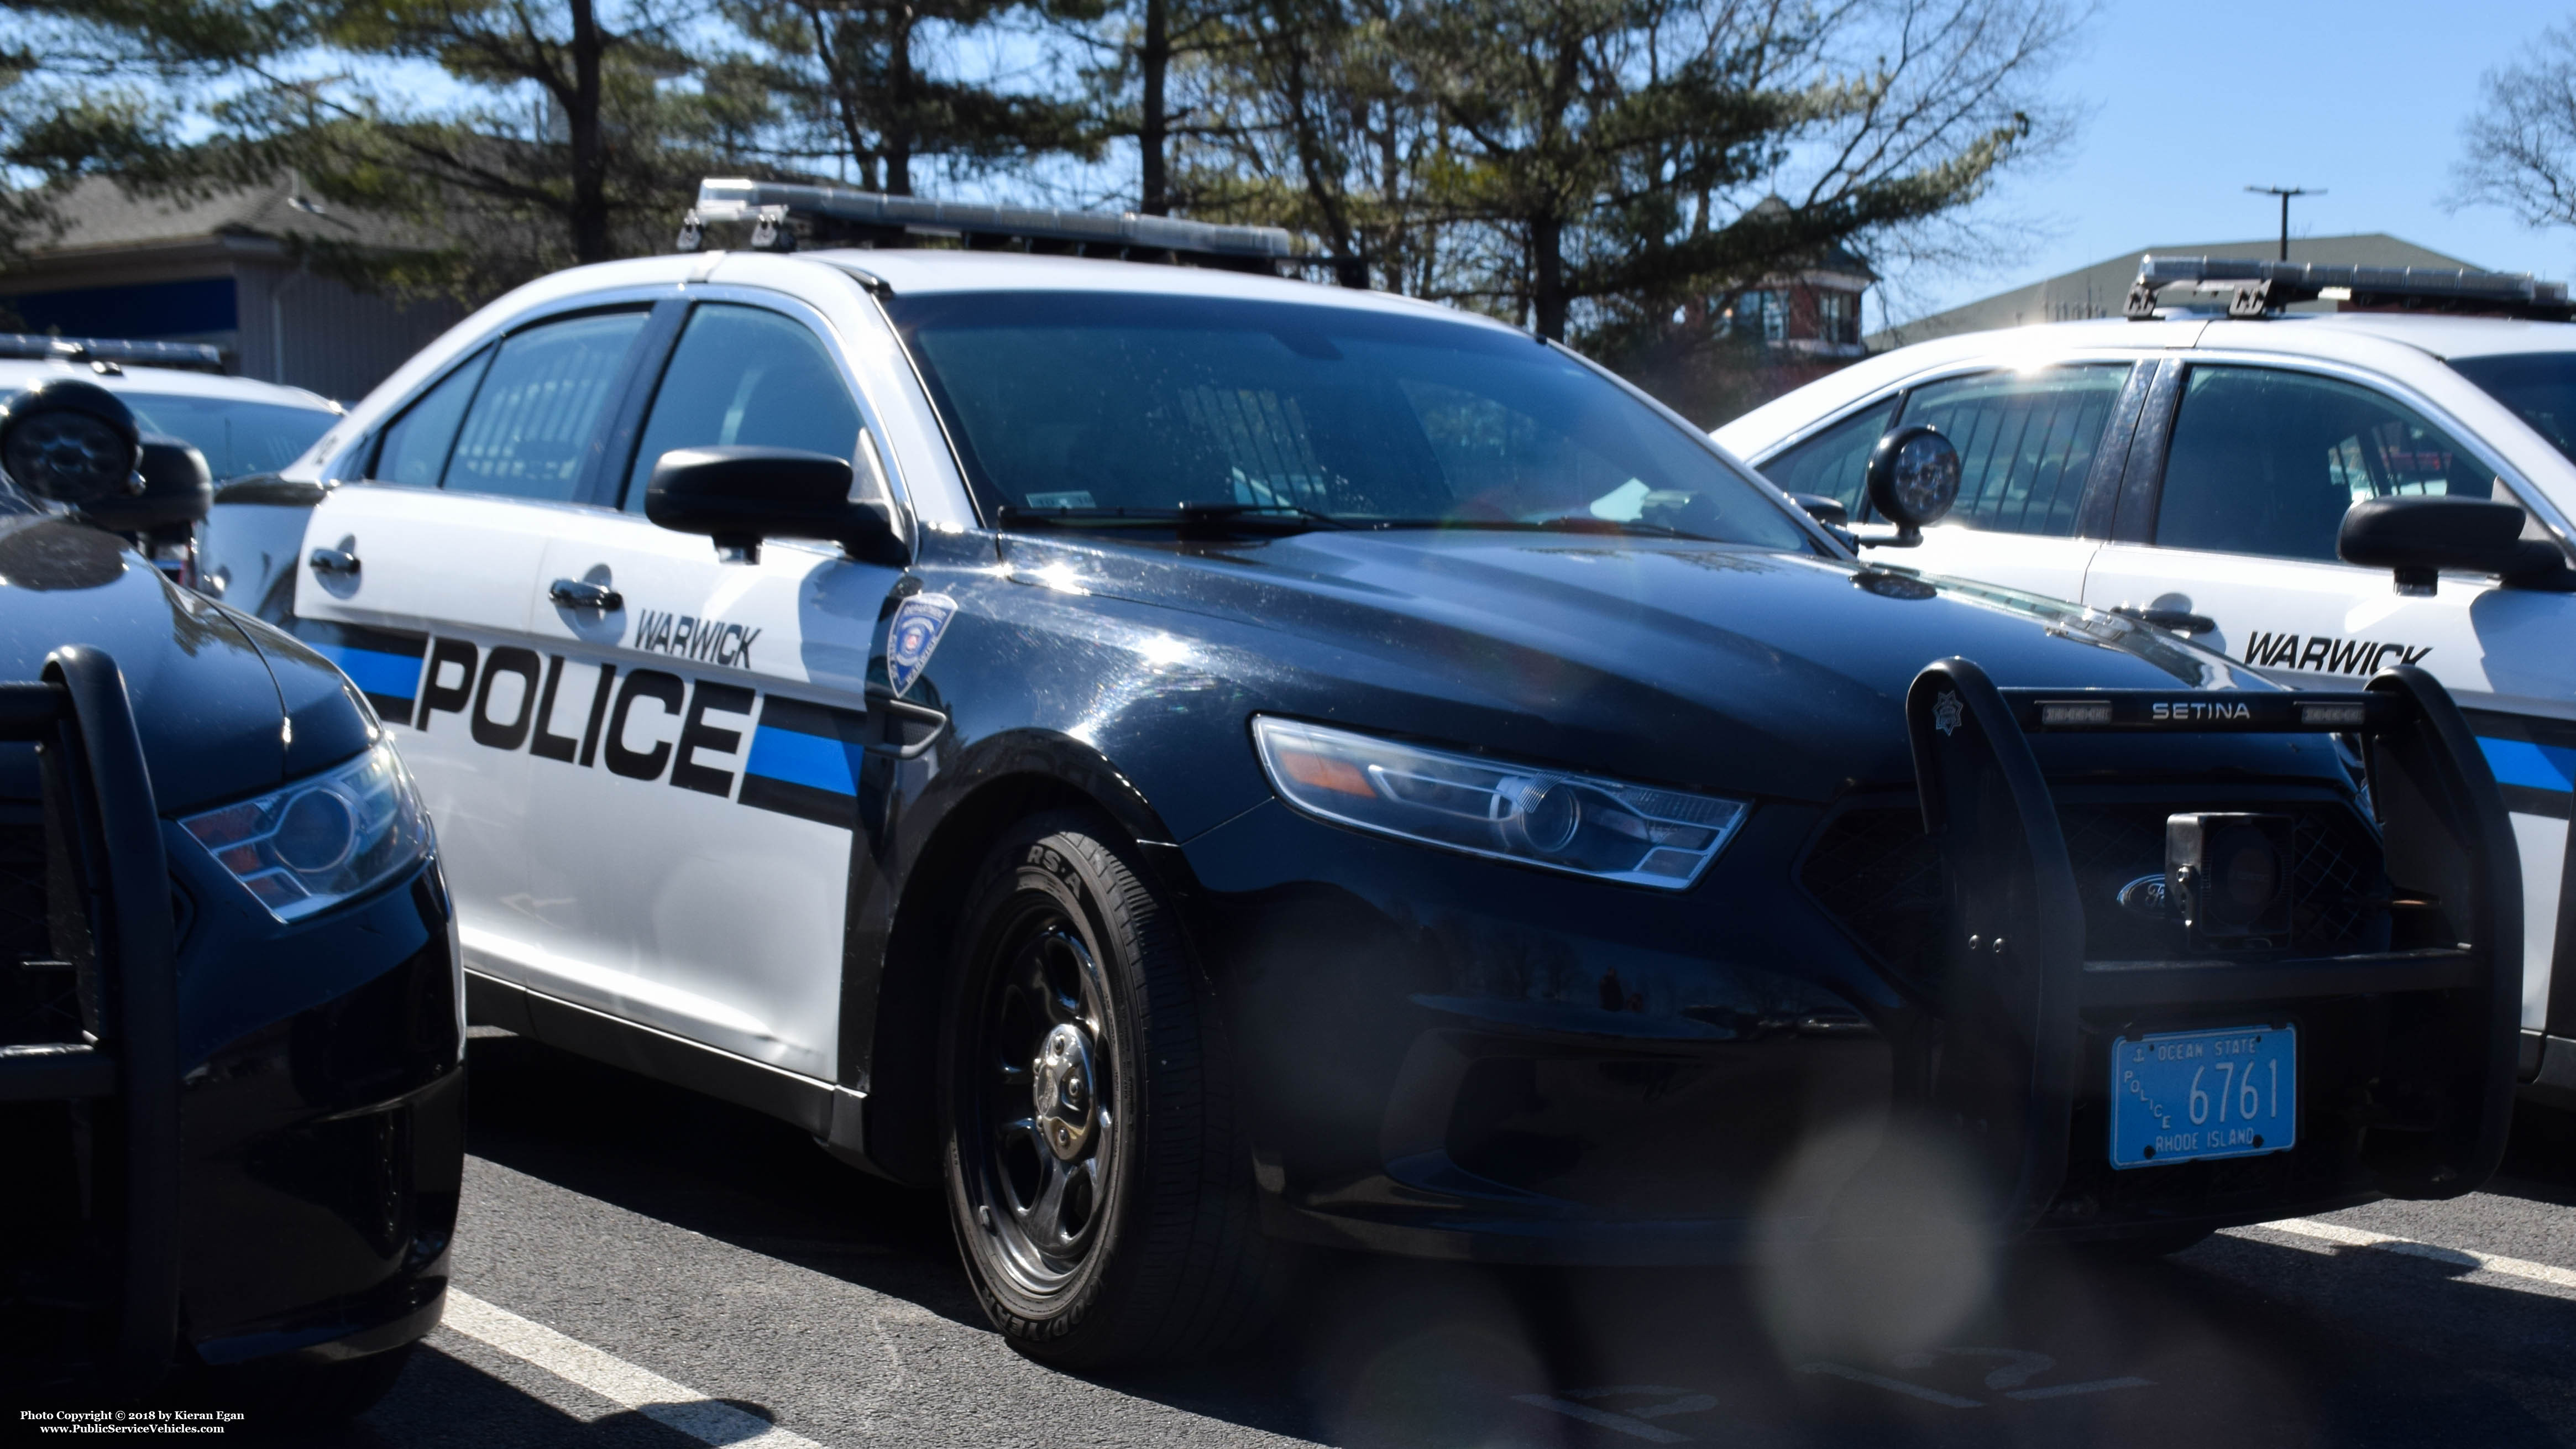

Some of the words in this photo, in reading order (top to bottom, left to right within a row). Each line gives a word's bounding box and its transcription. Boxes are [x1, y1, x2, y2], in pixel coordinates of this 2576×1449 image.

[633, 609, 762, 669] WARWICK
[2244, 631, 2434, 676] WARWICK
[416, 636, 756, 799] POLICE
[2152, 702, 2250, 720] SETINA
[2158, 1043, 2203, 1061] OCEAN
[2215, 1038, 2256, 1056] STATE
[2124, 1070, 2171, 1129] POLICE
[2189, 1058, 2277, 1125] 6761
[2156, 1131, 2199, 1152] RHODE
[2207, 1127, 2254, 1148] ISLAND
[982, 1263, 1107, 1341] OODYEAR
